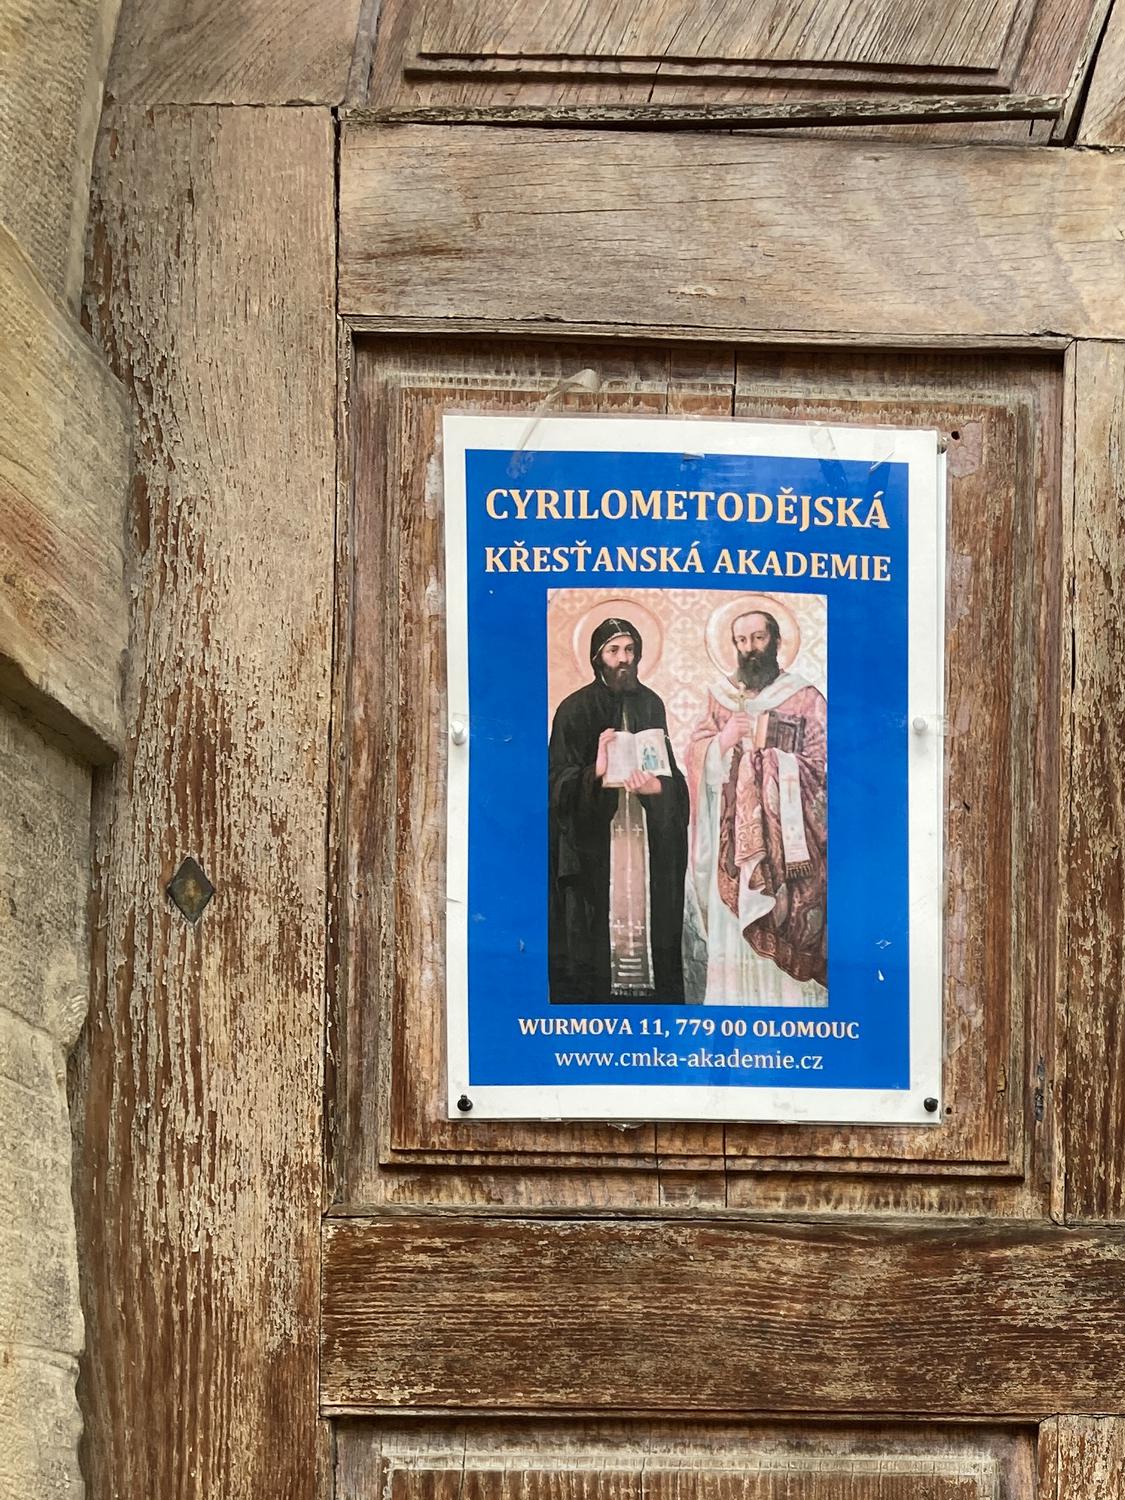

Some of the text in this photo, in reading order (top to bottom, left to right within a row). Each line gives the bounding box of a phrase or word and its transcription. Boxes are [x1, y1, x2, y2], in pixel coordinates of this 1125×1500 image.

[485, 486, 890, 532] CYRILOMETODĚJSKÁ
[484, 540, 892, 581] KŘESŤANSKÁ AKADEMIE
[518, 1018, 860, 1040] WURMOVA 11, 779 00 OLOMOUC
[555, 1047, 824, 1071] www.cmka-akademie.cz
